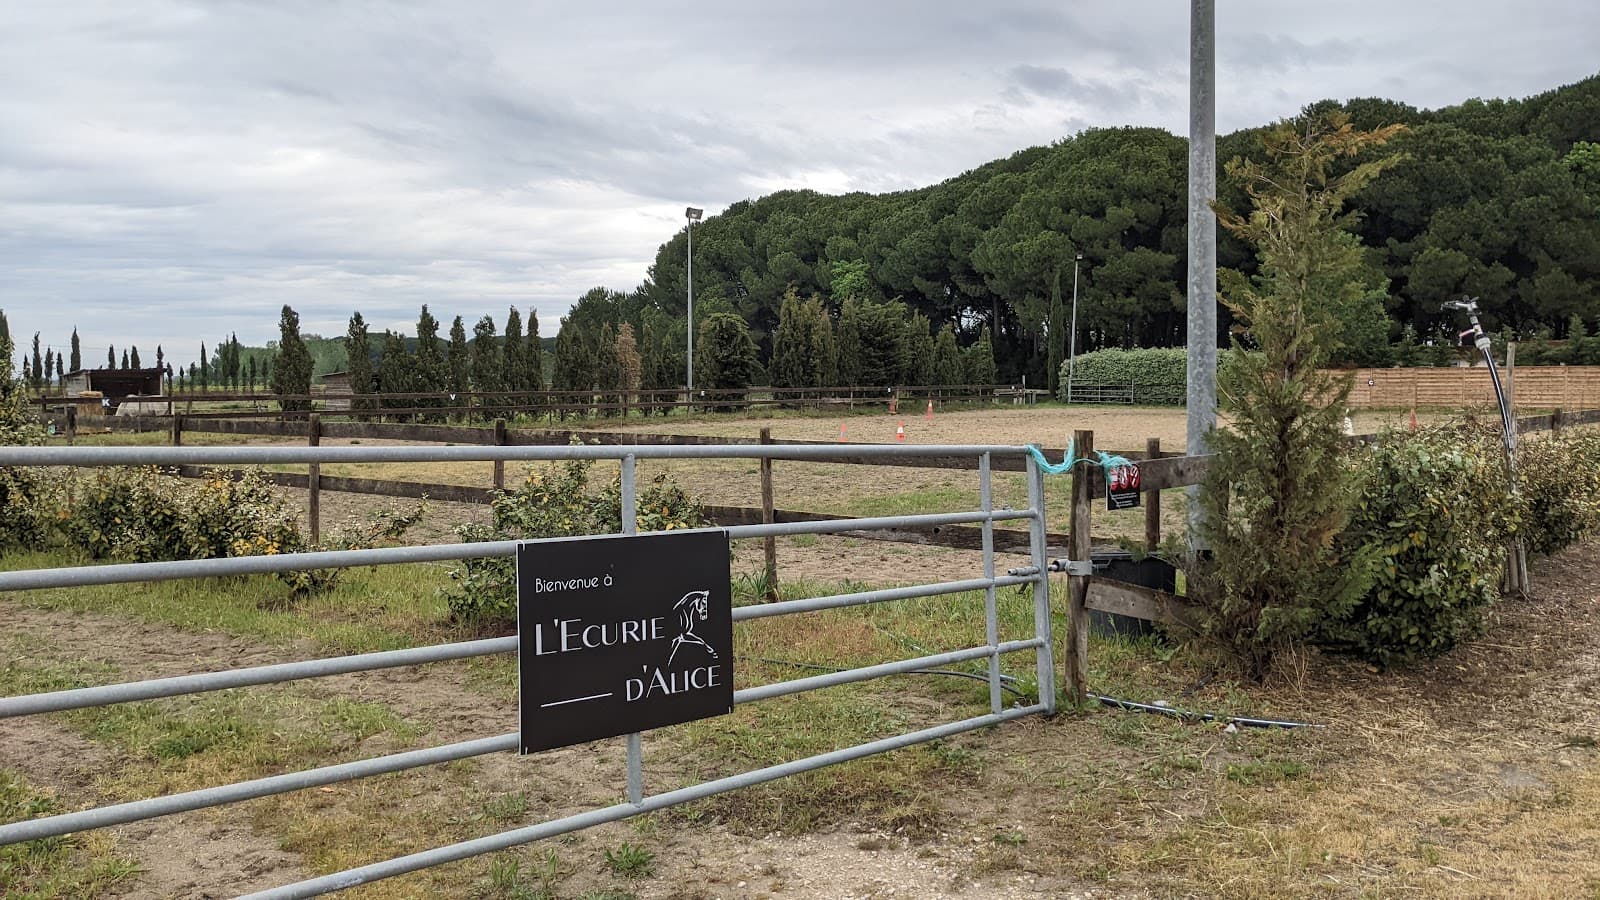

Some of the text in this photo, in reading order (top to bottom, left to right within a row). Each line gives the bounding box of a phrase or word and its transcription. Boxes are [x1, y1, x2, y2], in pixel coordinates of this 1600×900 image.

[101, 398, 110, 407] K
[535, 573, 613, 594] Bienvenue à
[535, 616, 665, 656] L'ECURIE
